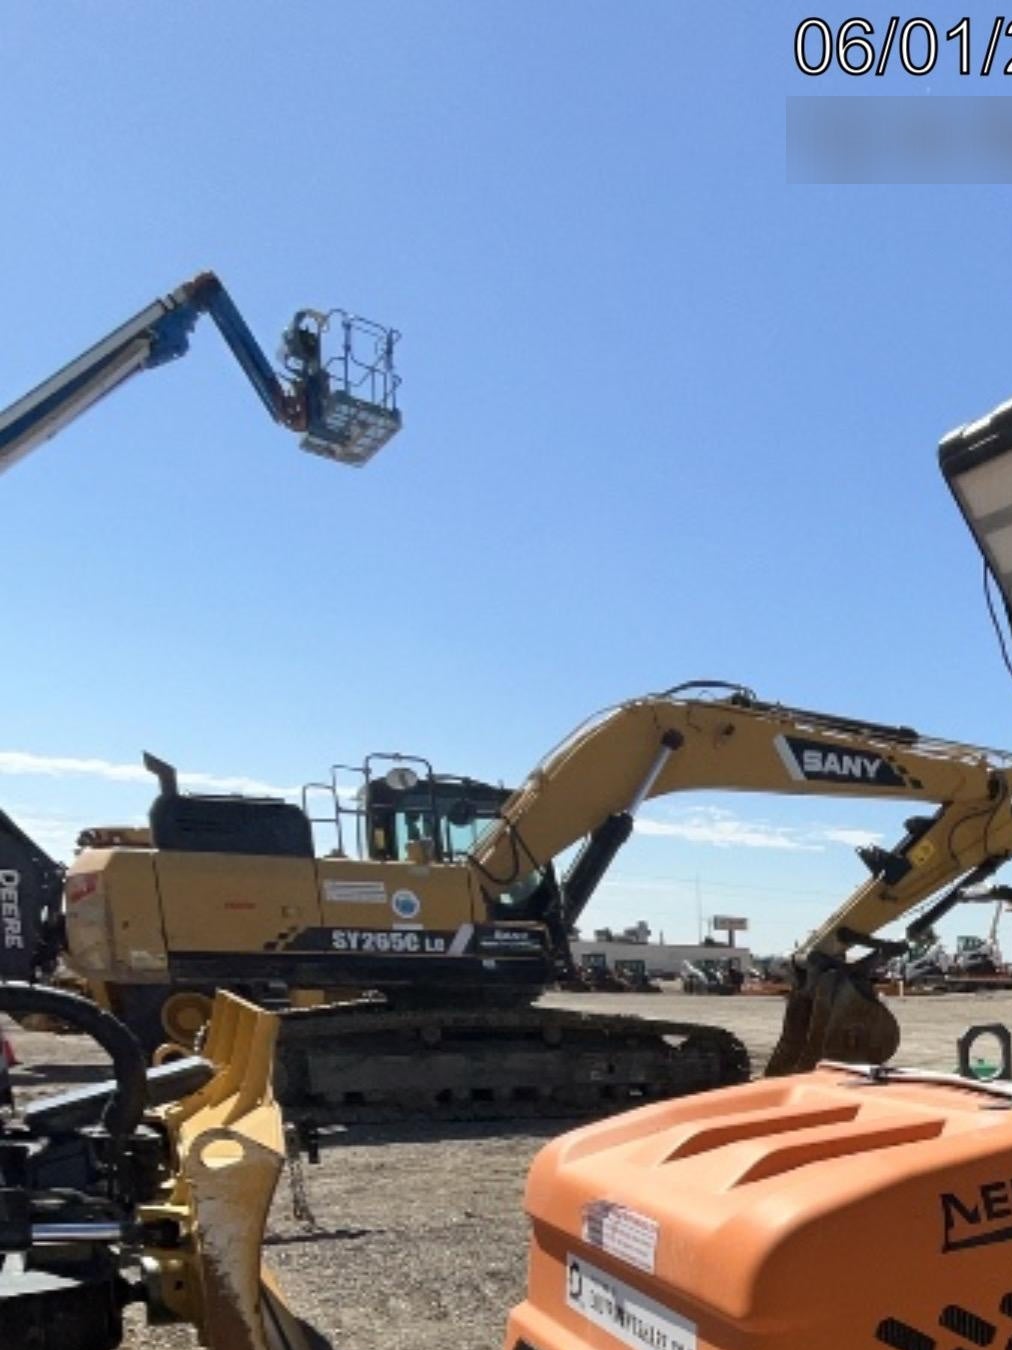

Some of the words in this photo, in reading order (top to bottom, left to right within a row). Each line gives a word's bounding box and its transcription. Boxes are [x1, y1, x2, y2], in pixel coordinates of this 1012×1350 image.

[802, 750, 881, 778] SANY
[0, 869, 24, 949] DEERE
[331, 930, 420, 952] SY265C
